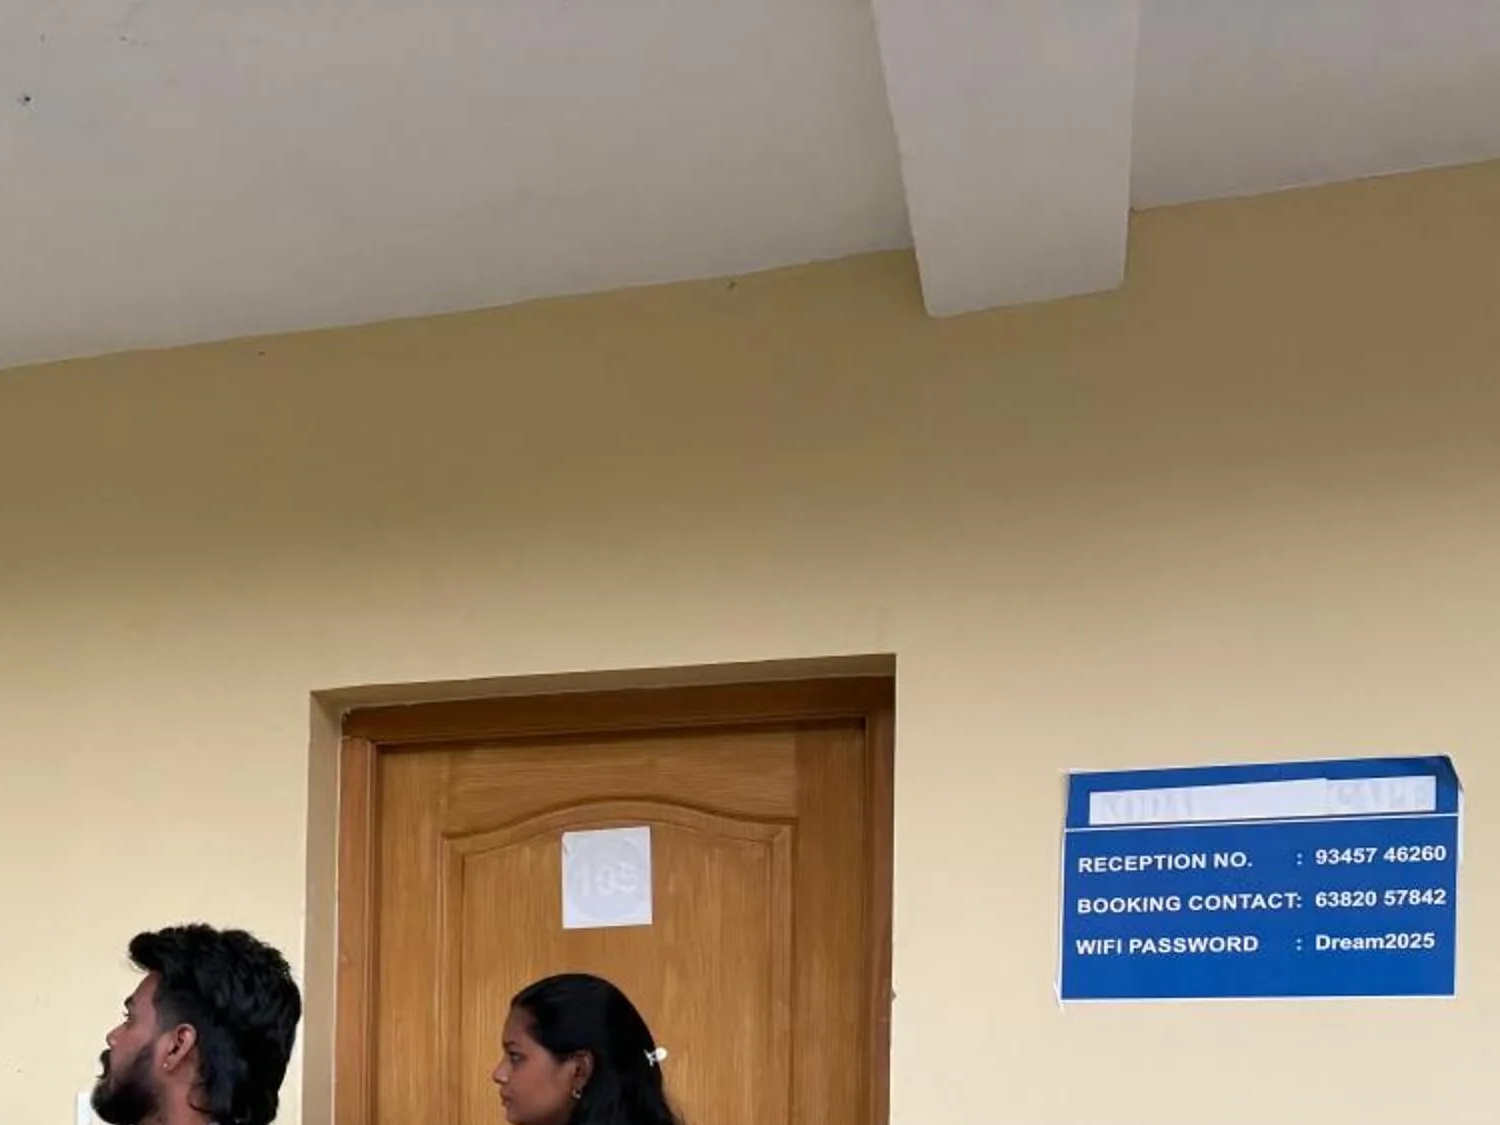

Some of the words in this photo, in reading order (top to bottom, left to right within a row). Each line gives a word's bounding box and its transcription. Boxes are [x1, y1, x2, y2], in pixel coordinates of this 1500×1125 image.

[1078, 853, 1206, 873] RECEPTION
[1213, 851, 1252, 869] NO.
[1315, 847, 1378, 865] 93457
[1383, 845, 1447, 863] 46260
[1077, 895, 1181, 914] BOOKING
[1315, 890, 1378, 907] 63820
[1383, 888, 1447, 906] 57842
[1076, 938, 1122, 955] WIFI
[1129, 935, 1259, 954] PASSWORD
[1315, 932, 1436, 951] Dream2025
